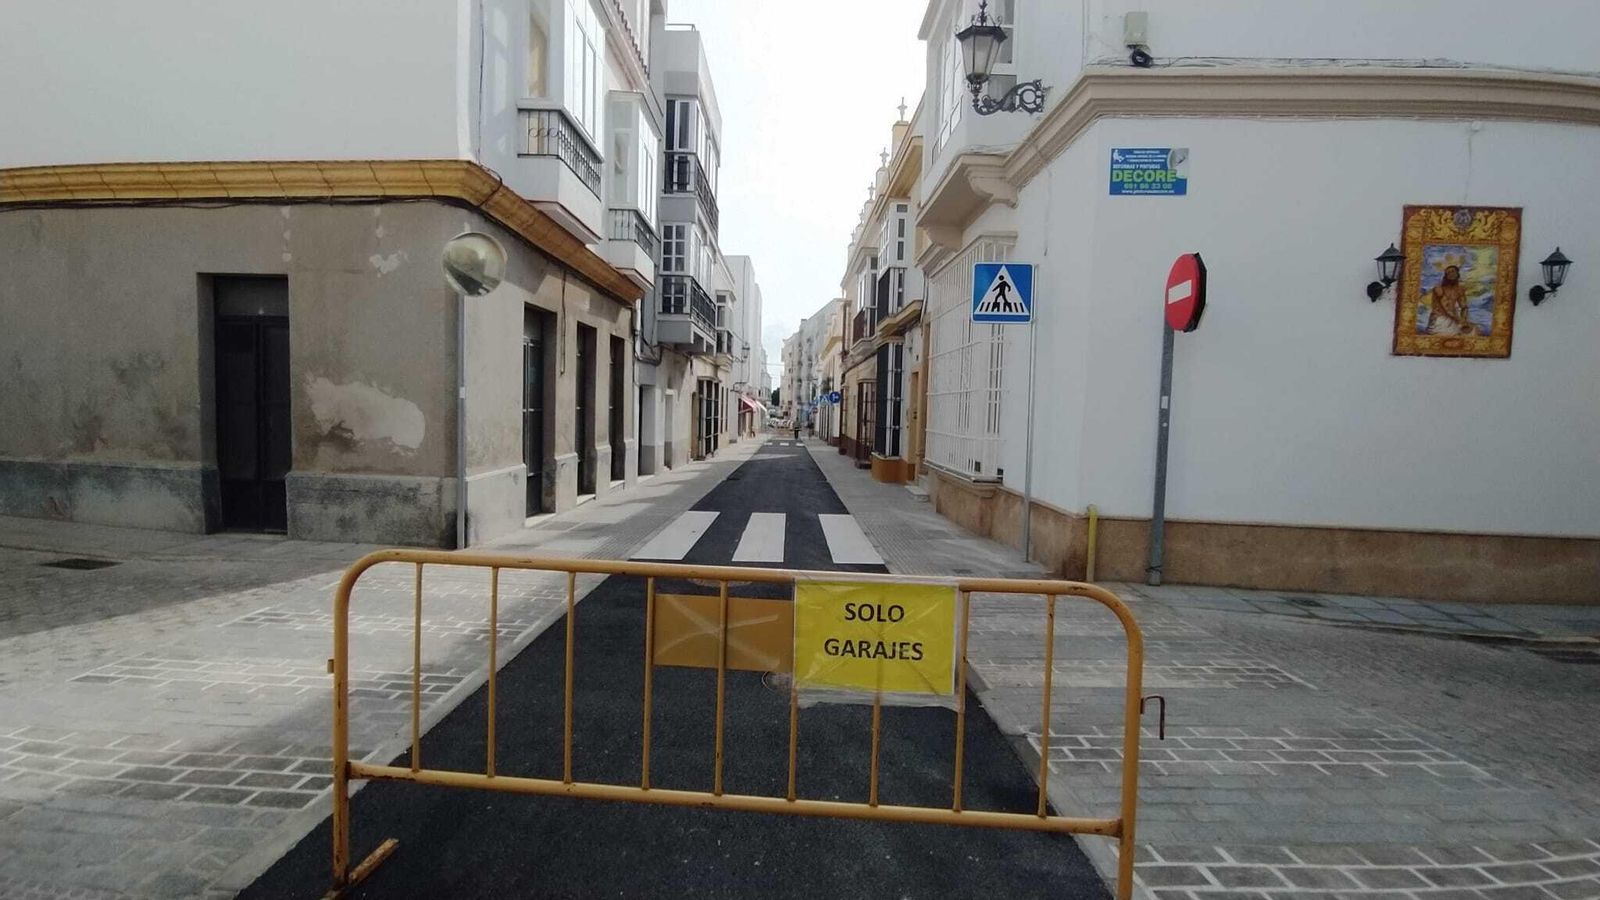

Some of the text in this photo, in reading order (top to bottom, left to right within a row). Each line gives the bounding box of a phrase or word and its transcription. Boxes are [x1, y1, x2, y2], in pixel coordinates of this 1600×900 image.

[1112, 169, 1177, 183] DECORE
[844, 603, 905, 623] SOLO
[824, 638, 923, 661] GARAJES
